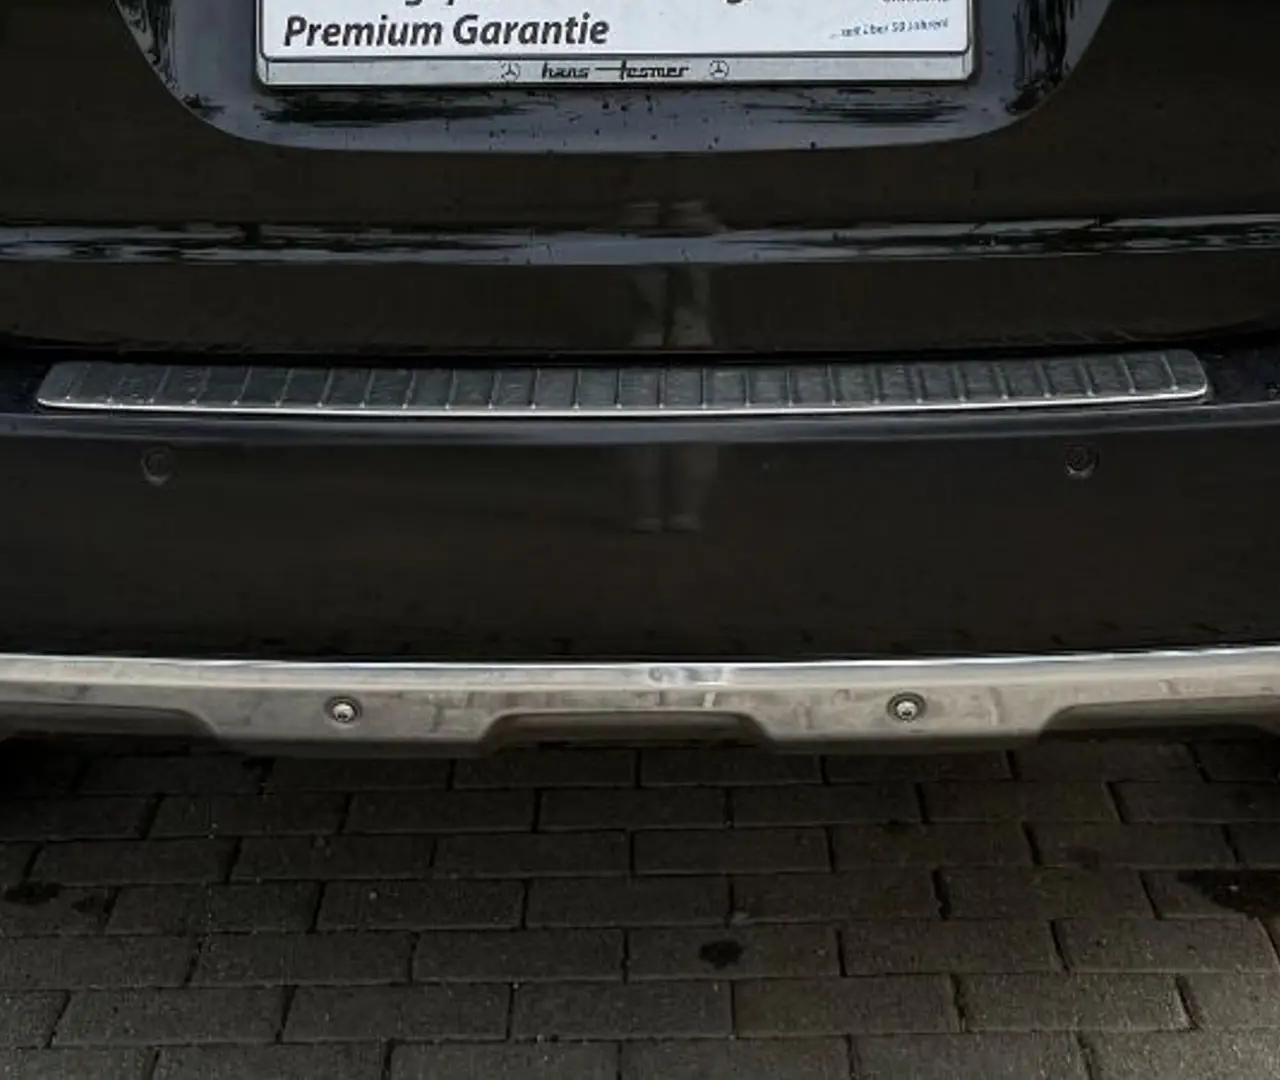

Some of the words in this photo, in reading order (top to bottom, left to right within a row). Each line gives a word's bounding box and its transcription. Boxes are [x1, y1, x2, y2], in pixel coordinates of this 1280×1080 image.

[283, 14, 442, 47] Premium
[452, 12, 610, 46] Garantie
[541, 60, 590, 79] hans
